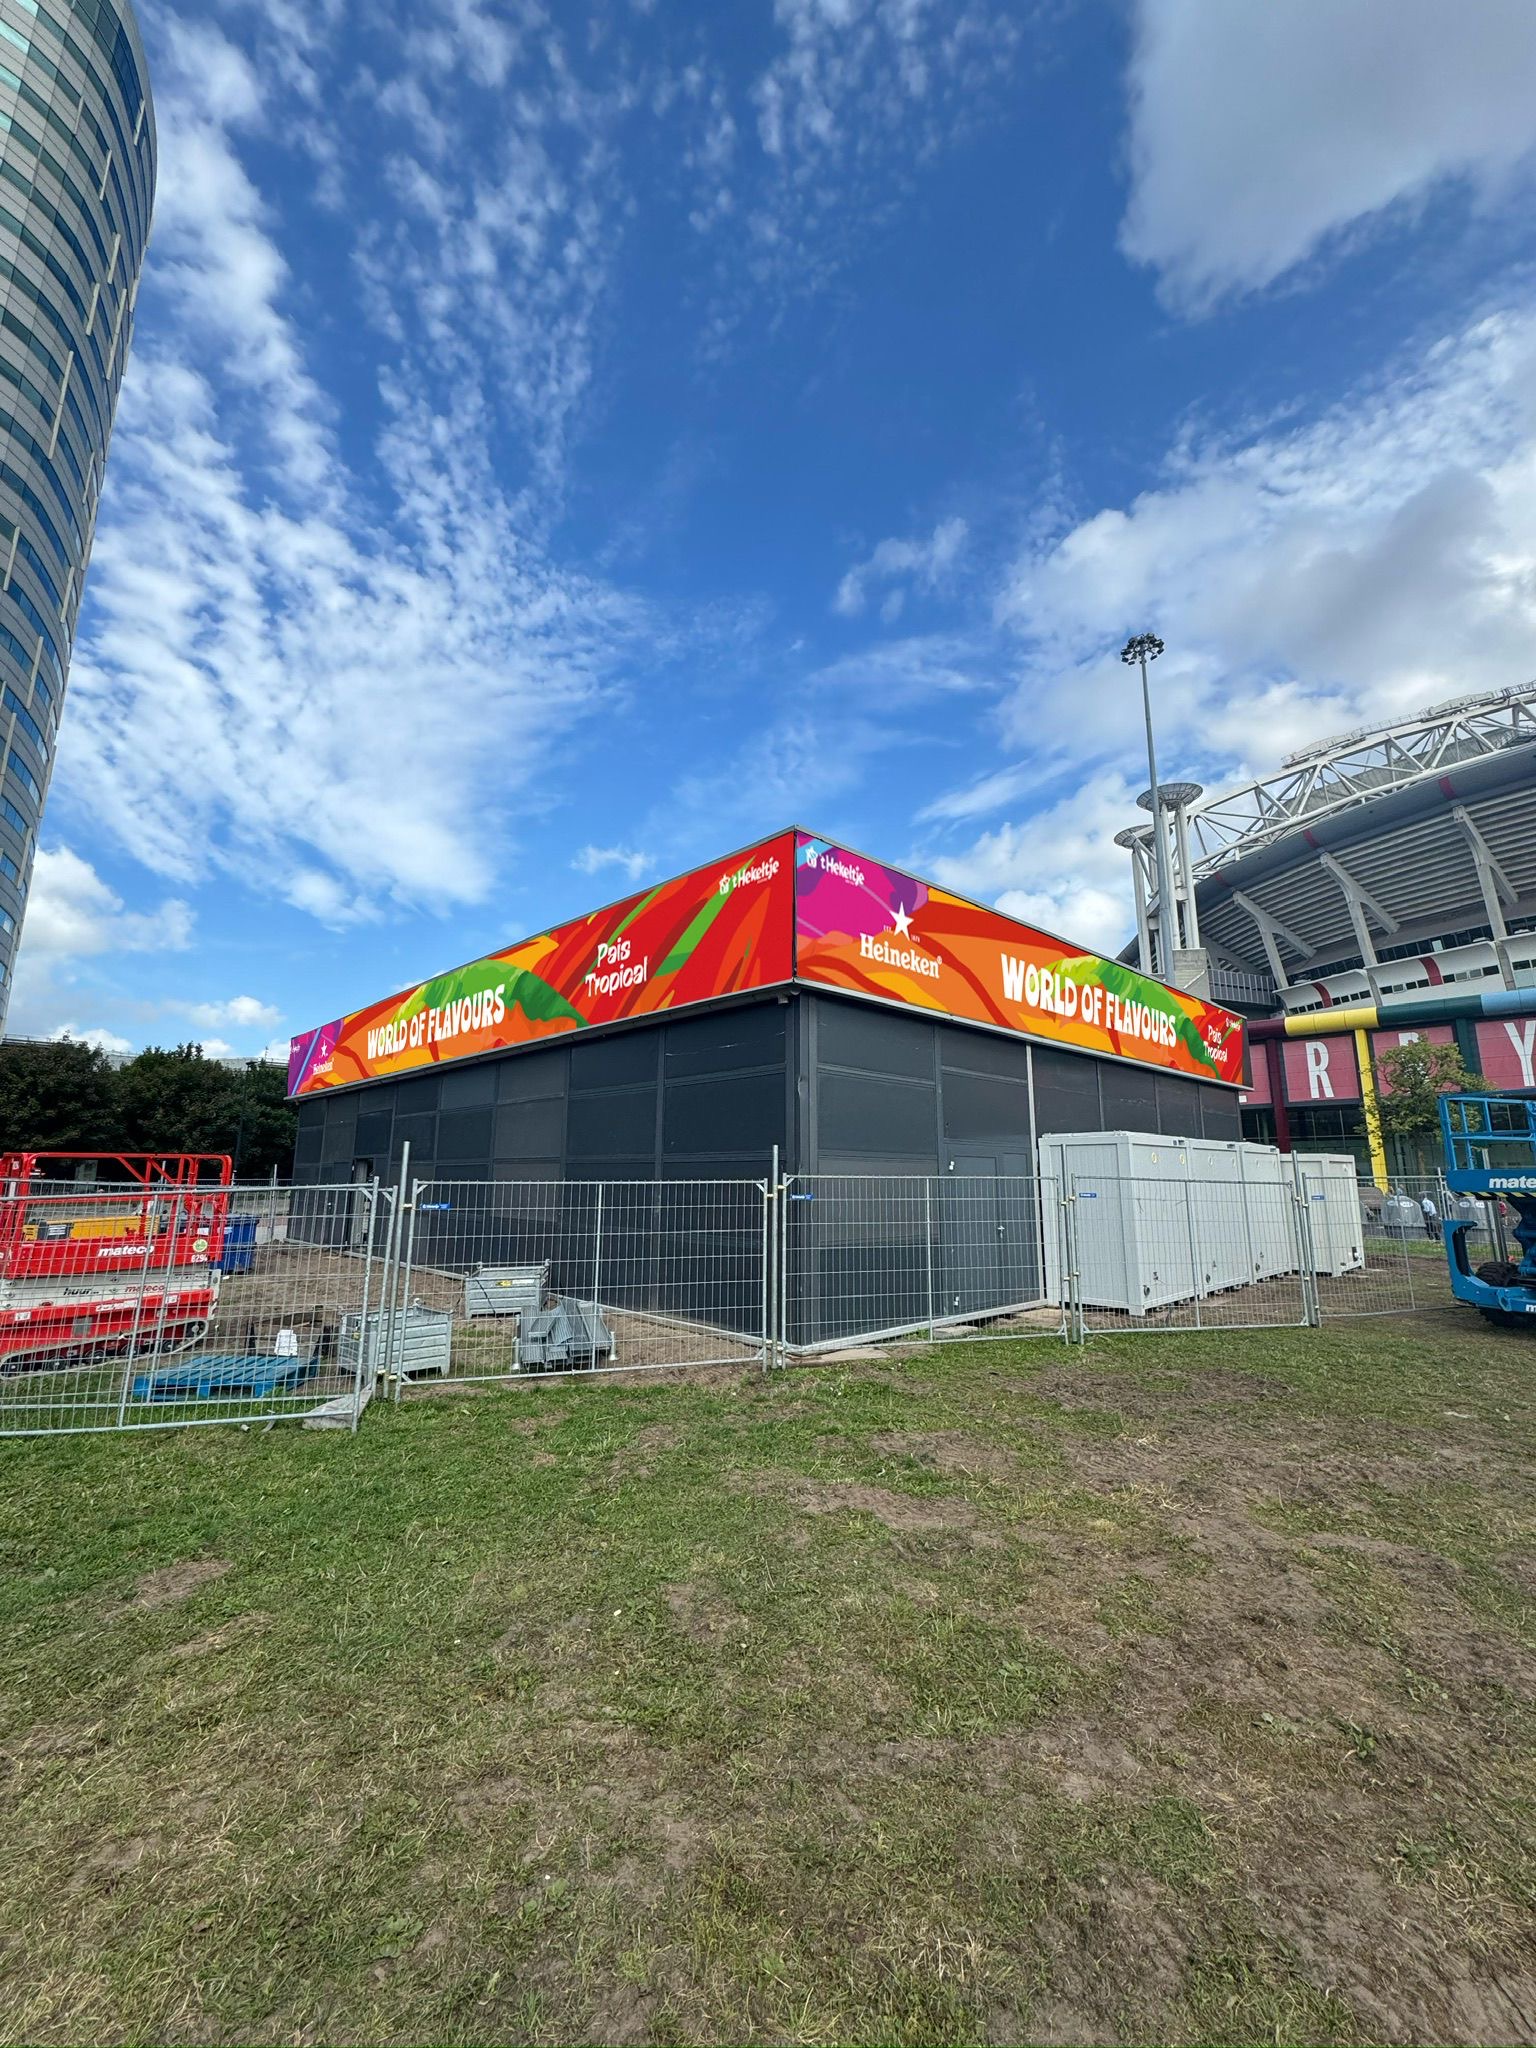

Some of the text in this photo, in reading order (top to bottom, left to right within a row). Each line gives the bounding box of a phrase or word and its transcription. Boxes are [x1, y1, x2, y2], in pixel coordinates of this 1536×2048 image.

[585, 955, 648, 998] Tropical
[1000, 953, 1178, 1048] WORLD OF FLAVOURS
[367, 983, 506, 1060] WORLD OF FLAVOURS
[97, 1245, 155, 1259] mateco
